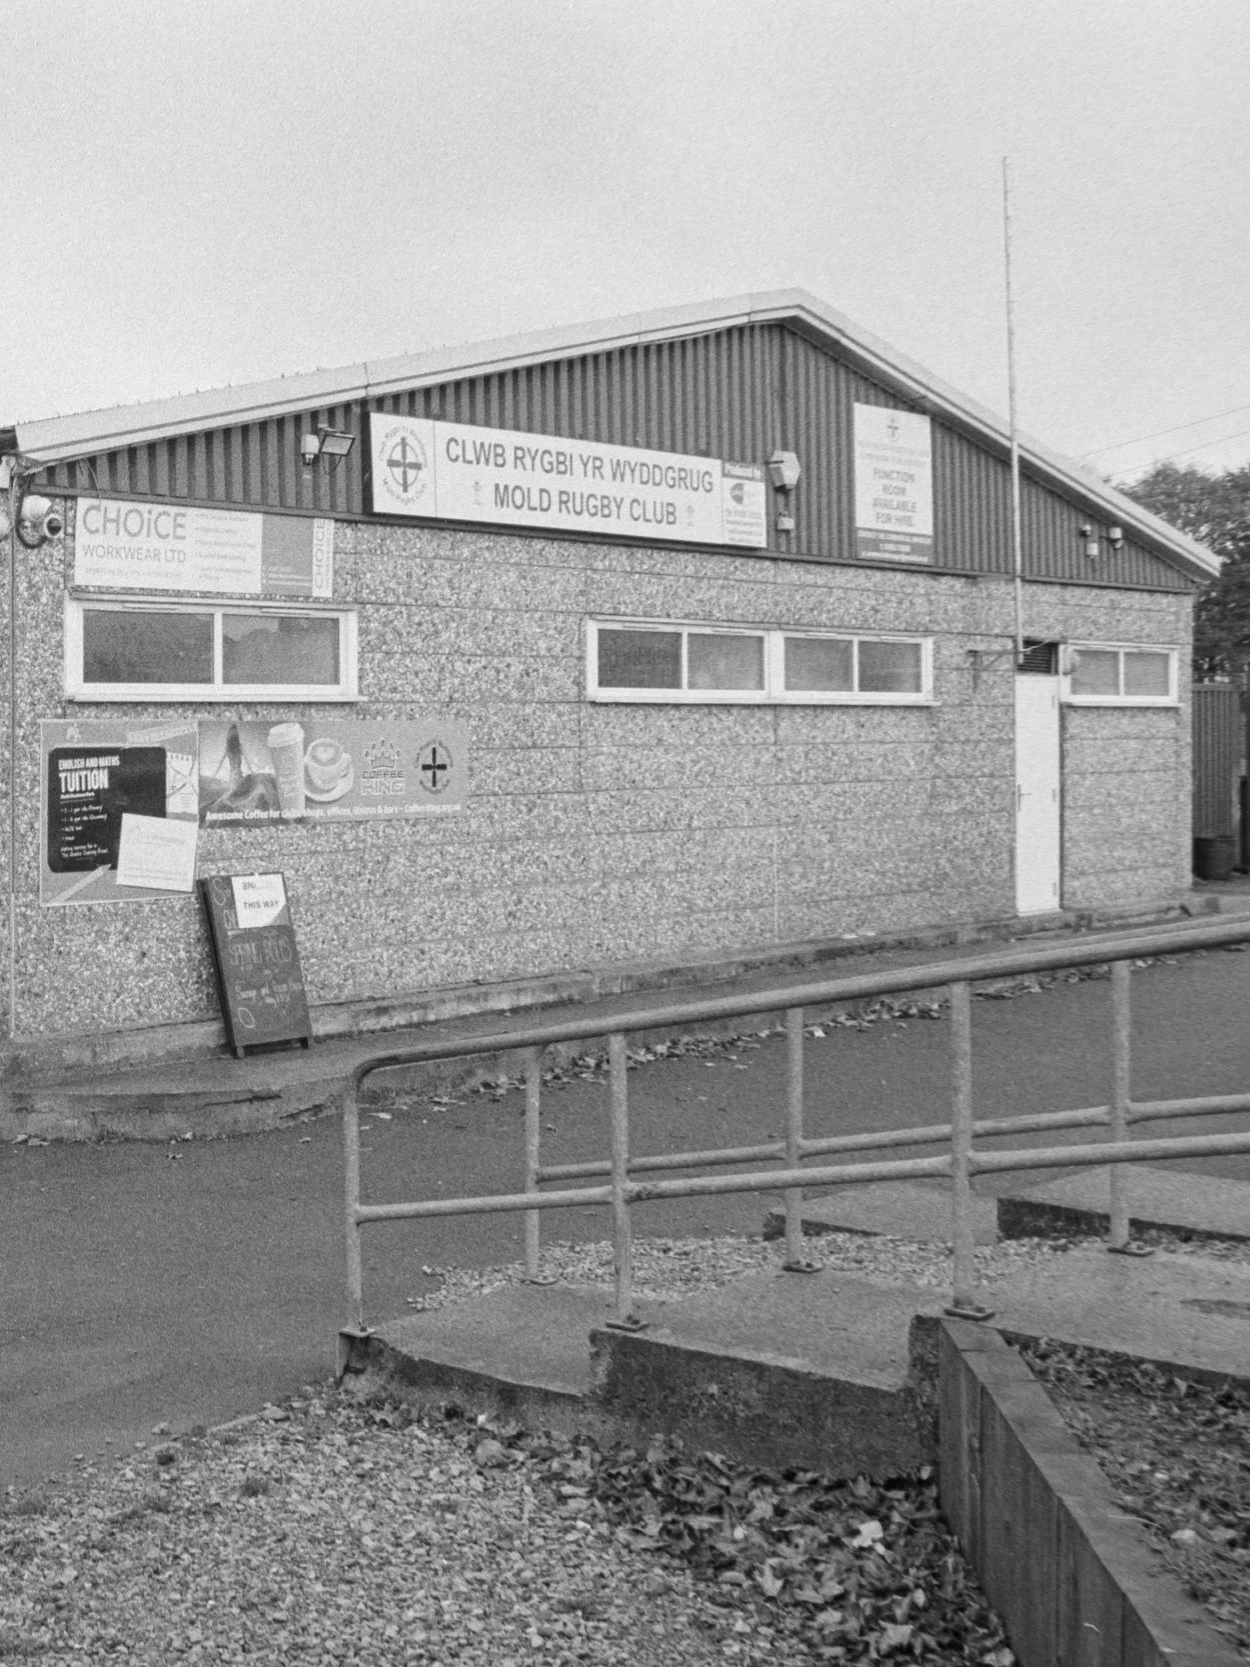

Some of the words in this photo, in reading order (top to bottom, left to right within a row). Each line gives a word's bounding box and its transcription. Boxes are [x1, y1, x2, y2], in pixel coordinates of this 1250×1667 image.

[445, 436, 507, 469] CLWB
[513, 445, 575, 478] RYGBI
[579, 454, 605, 481] YR
[609, 457, 714, 494] WYDDGRUG
[873, 467, 916, 484] FUNCTION
[493, 482, 552, 514] MOLD
[557, 489, 625, 522] RUGBY
[628, 498, 678, 526] CLUB
[82, 543, 162, 563] WORKWEAR
[164, 547, 187, 564] LTD
[58, 758, 85, 771] ENGLISH
[86, 756, 98, 768] AND
[58, 767, 110, 793] TUITION
[361, 769, 405, 779] COFFEE
[361, 779, 407, 796] KING
[206, 810, 244, 821] Awesome
[244, 809, 269, 820] Coffee
[269, 808, 281, 819] for
[243, 901, 261, 910] THIS
[263, 899, 280, 909] WAY
